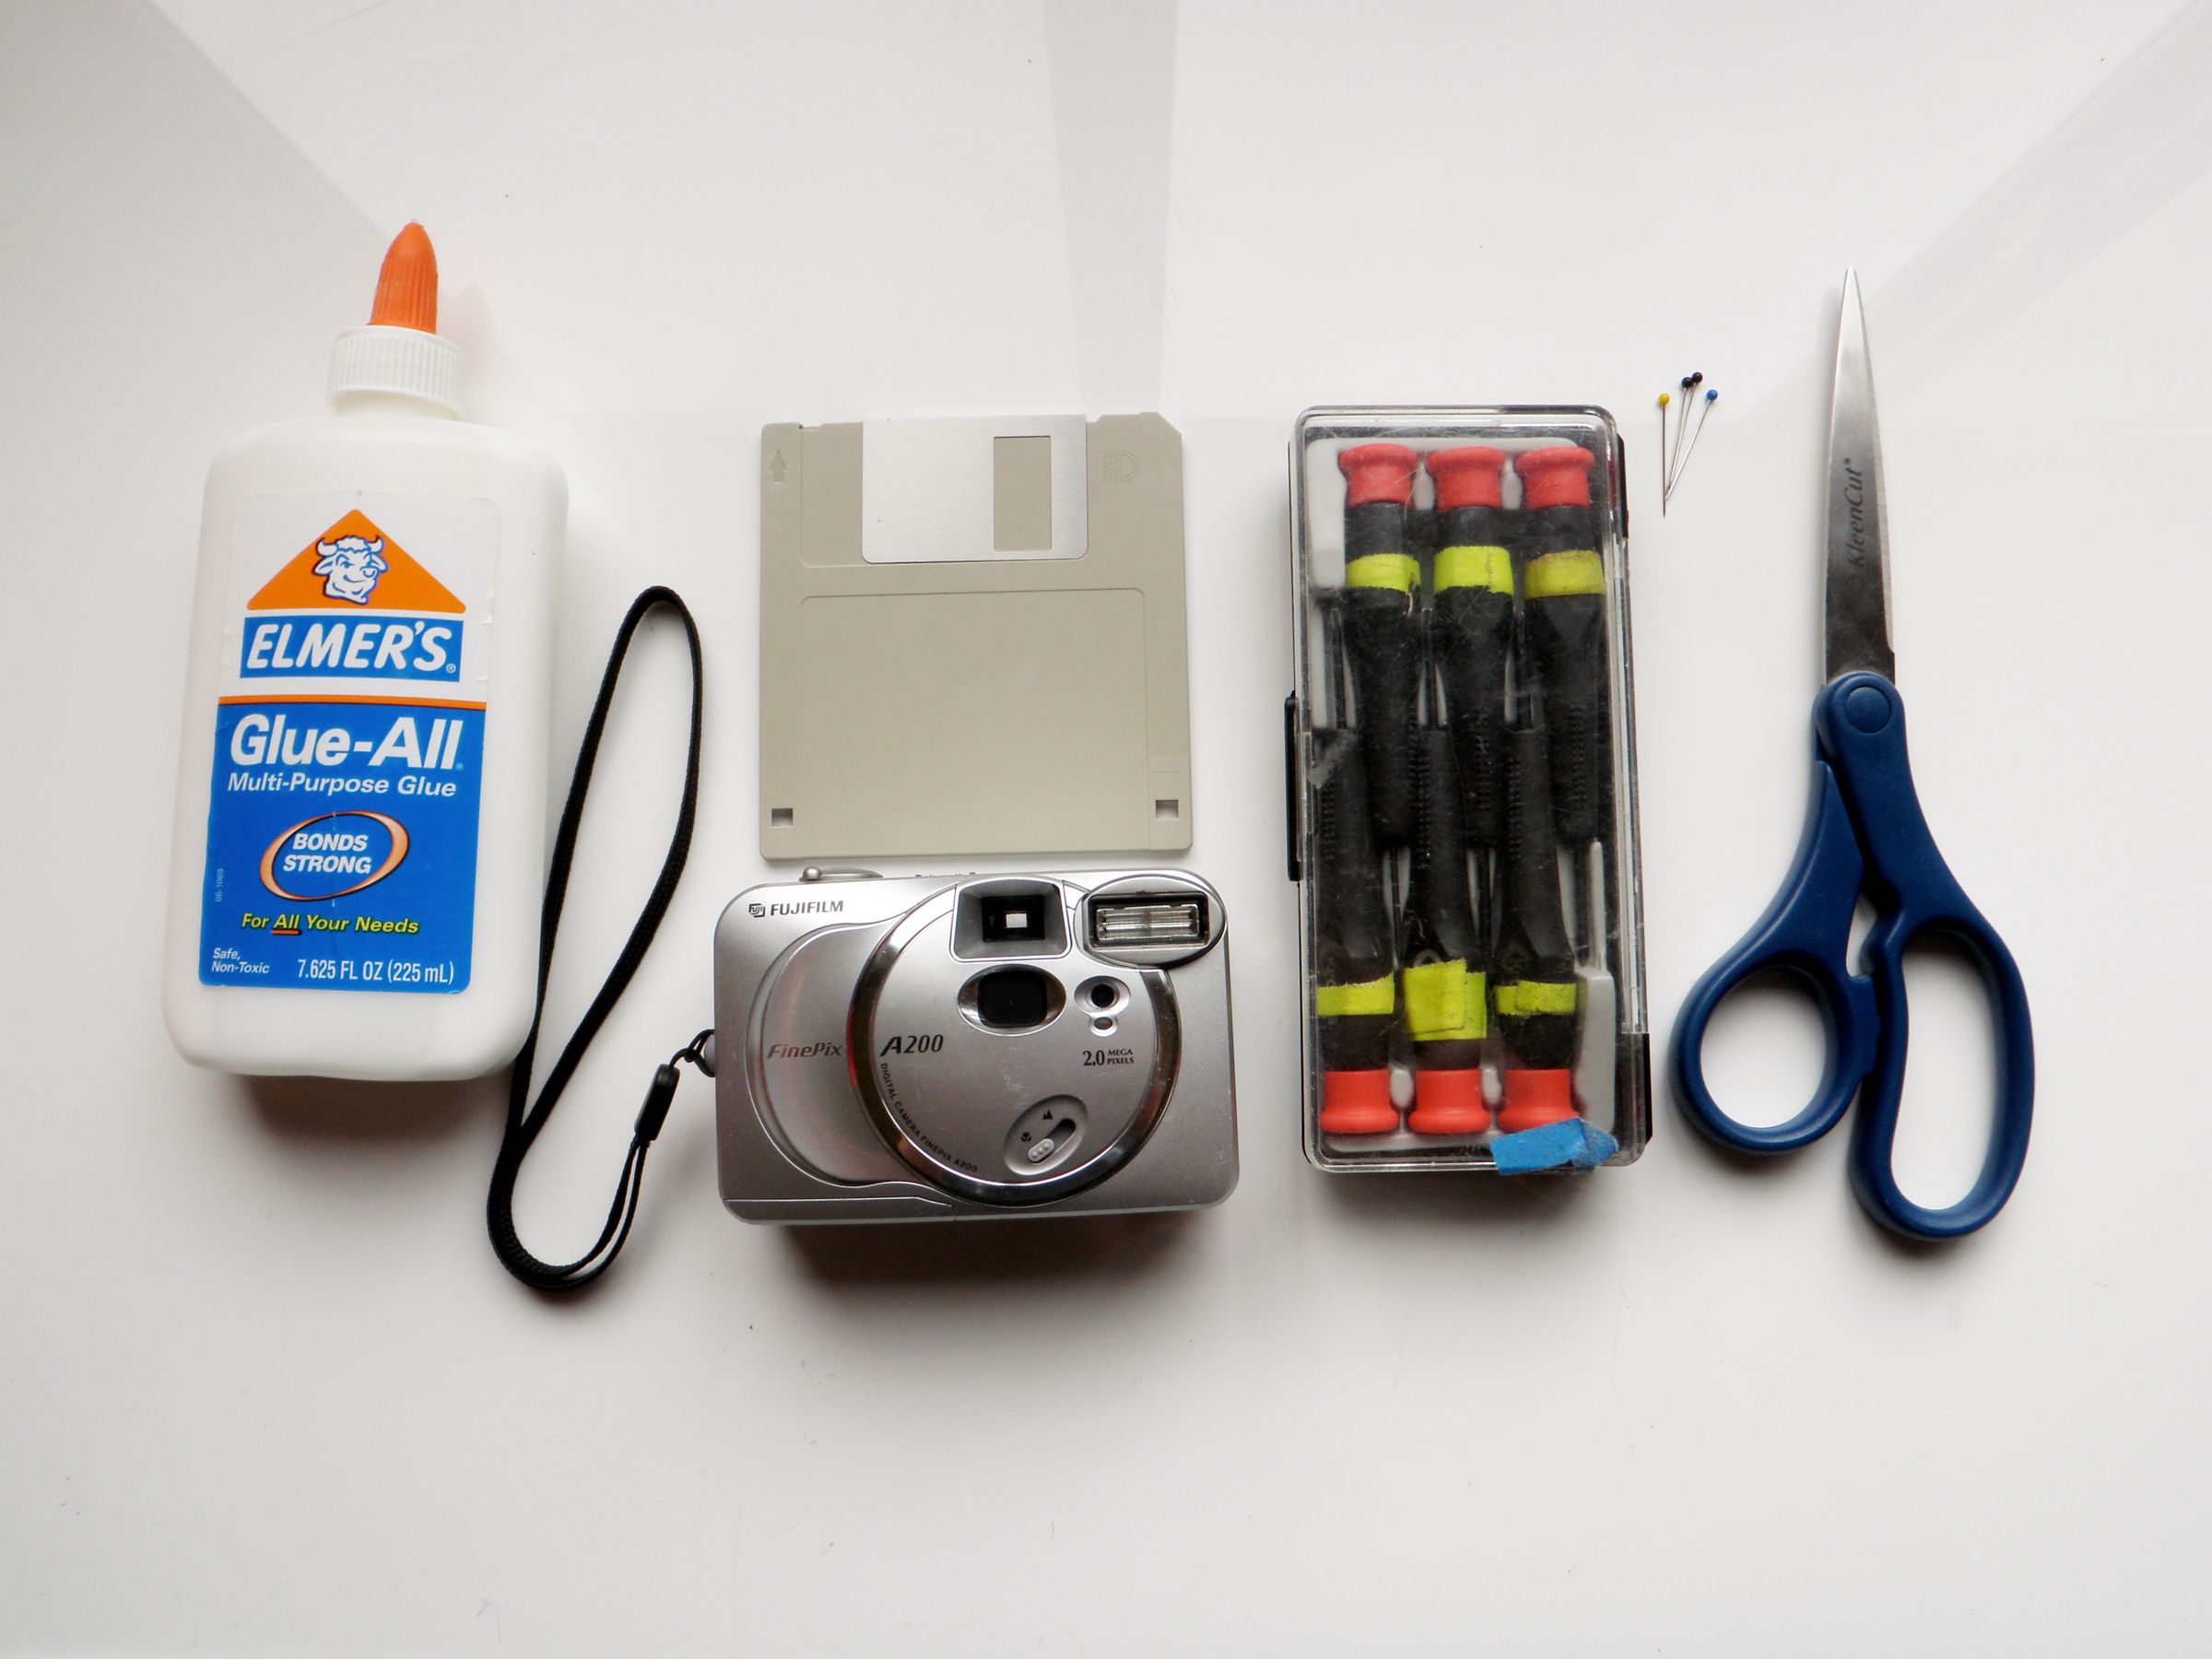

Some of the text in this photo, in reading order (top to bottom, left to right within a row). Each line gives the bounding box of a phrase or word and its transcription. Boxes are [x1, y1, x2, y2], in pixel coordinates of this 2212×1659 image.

[1844, 465, 1865, 568] KleenCut
[246, 621, 453, 672] ELMER'S
[230, 713, 464, 770] Glue-All
[228, 772, 457, 797] Multi-Purpose Glue
[292, 833, 369, 852] BONDS
[283, 854, 371, 875] STRONG
[771, 900, 844, 916] FUJIFILM
[241, 913, 419, 934] For All Your Needs
[213, 947, 241, 960] Safe,
[211, 961, 270, 974] Non-Toxic
[297, 959, 454, 985] 7.625 FL OZ (225 mL)
[767, 1042, 843, 1058] FinePix
[880, 1034, 944, 1057] A200
[1108, 1048, 1134, 1056] MEGA
[1082, 1050, 1105, 1066] 2.0
[881, 1063, 897, 1099] DIGITAL
[895, 1101, 921, 1136] CAMERA
[922, 1135, 952, 1161] FINEPIX
